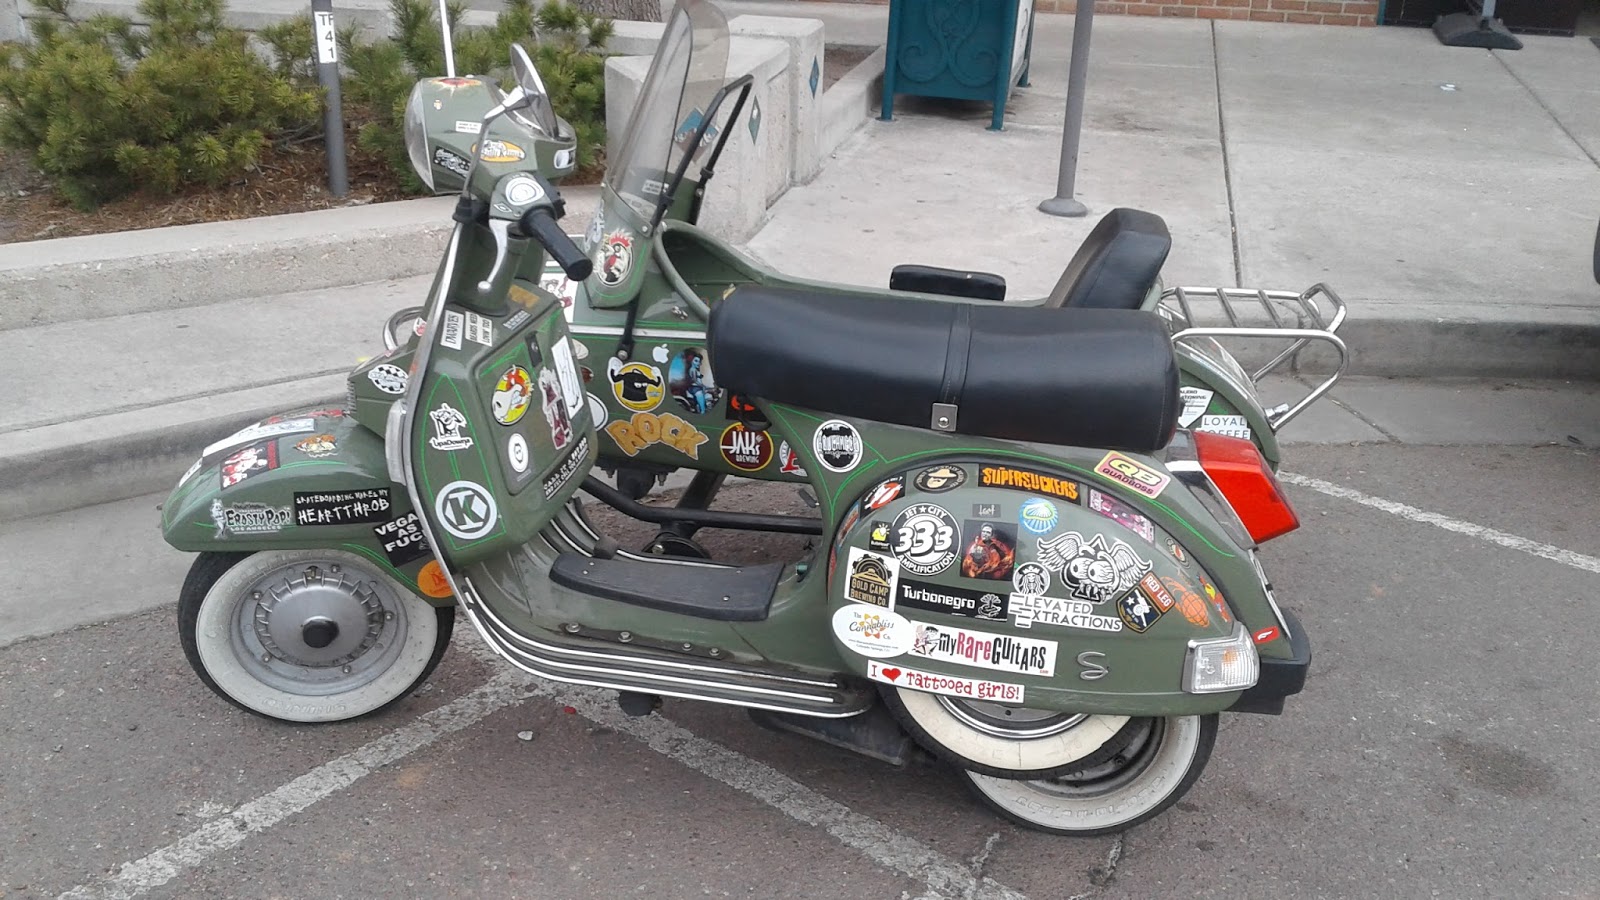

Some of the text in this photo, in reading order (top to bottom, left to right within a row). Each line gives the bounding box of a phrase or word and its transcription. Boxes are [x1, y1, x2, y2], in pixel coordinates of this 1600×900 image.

[325, 30, 333, 42] 4
[328, 47, 334, 59] 1
[1204, 417, 1245, 426] LOYAL
[604, 412, 709, 460] ROCK
[1200, 429, 1249, 439] FFEE
[736, 455, 760, 464] BREWING
[982, 467, 1078, 500] SUPERSUCKERS
[1102, 467, 1154, 495] QUADBOSS
[296, 489, 389, 504] SKATEBOARDING MAKES MY
[297, 498, 390, 525] HEARTTHROB
[904, 506, 948, 519] JET CITY
[374, 512, 419, 535] VEGA
[397, 523, 418, 538] AS
[384, 531, 424, 553] FUC
[895, 520, 954, 555] 333
[896, 551, 955, 574] AMPLIFICATION
[850, 588, 876, 603] BREWING
[851, 578, 889, 597] GOLD CAMP
[902, 584, 975, 610] Turbonegro
[1145, 575, 1172, 607] RED LEG
[871, 664, 877, 677] I
[978, 682, 1020, 700] girls!
